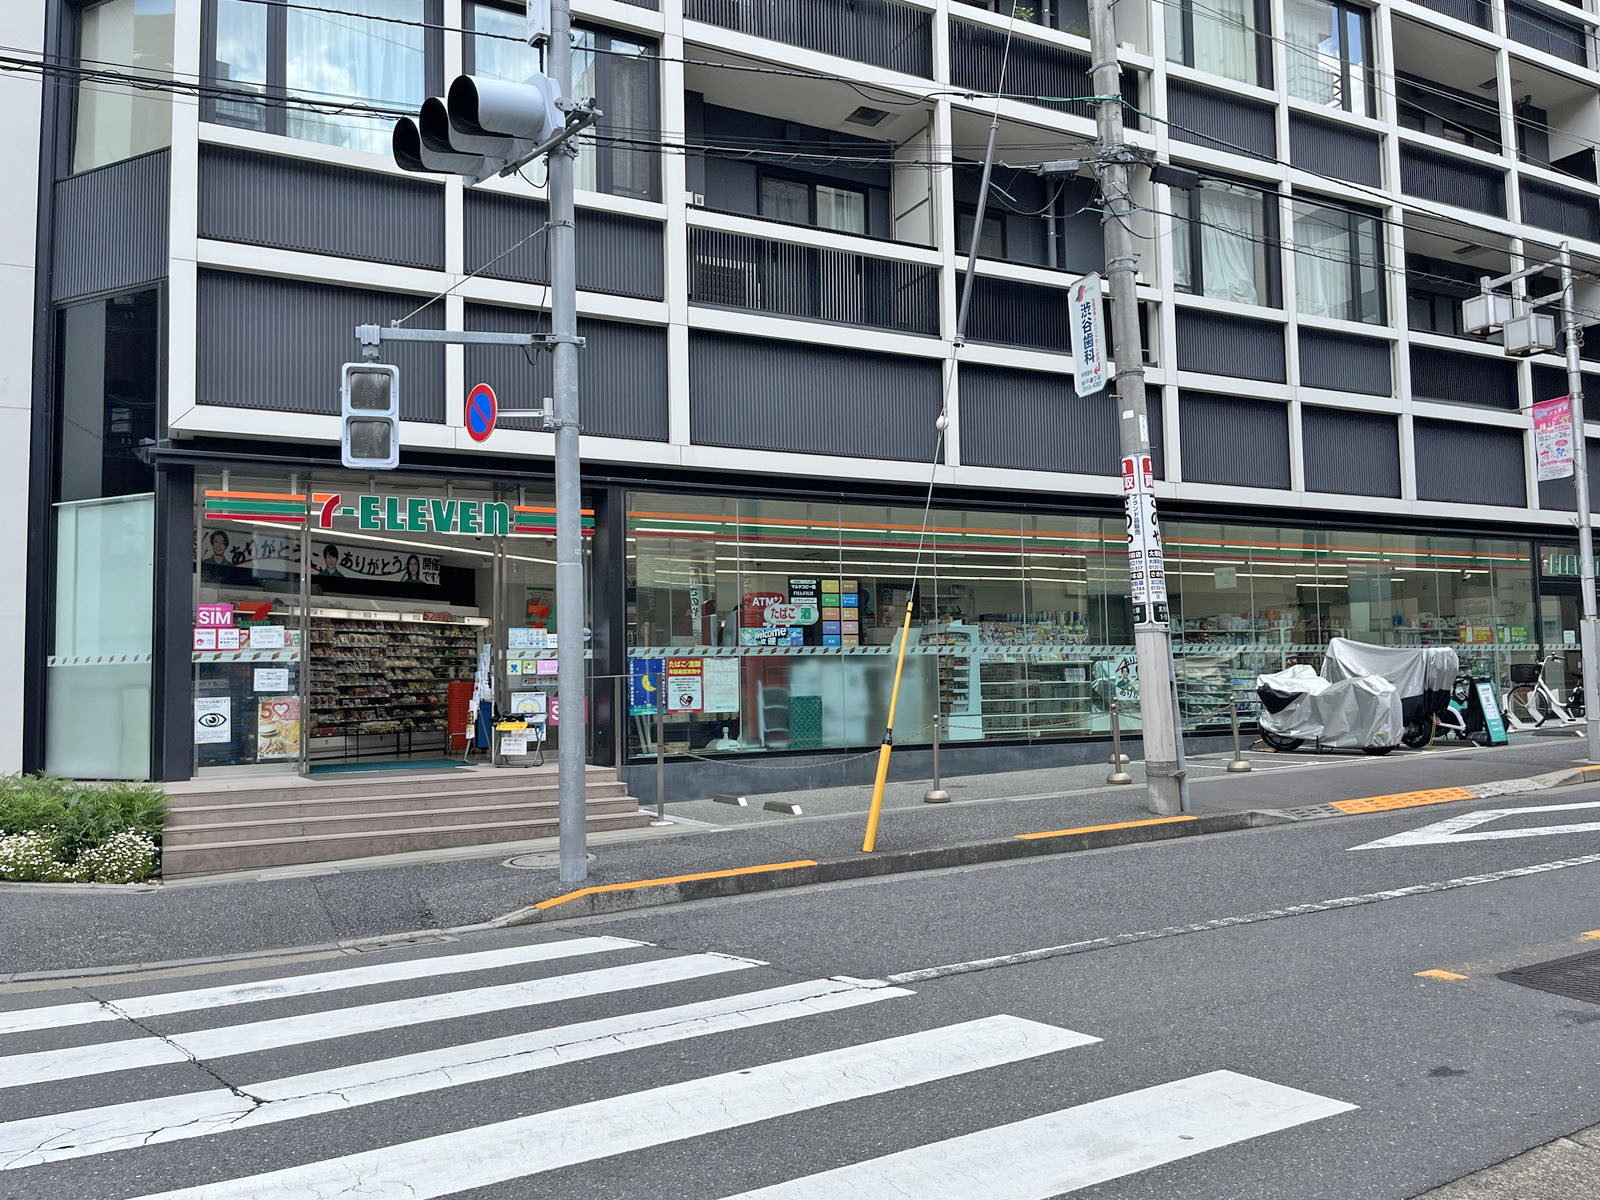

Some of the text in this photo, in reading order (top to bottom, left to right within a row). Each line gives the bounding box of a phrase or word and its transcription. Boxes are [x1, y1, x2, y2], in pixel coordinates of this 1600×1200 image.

[1080, 301, 1096, 365] 渋谷歯科
[340, 551, 402, 575] ありがとう
[752, 597, 778, 607] ATM
[198, 611, 232, 625] SIM
[770, 606, 796, 620] たばこ
[800, 606, 811, 620] 酒
